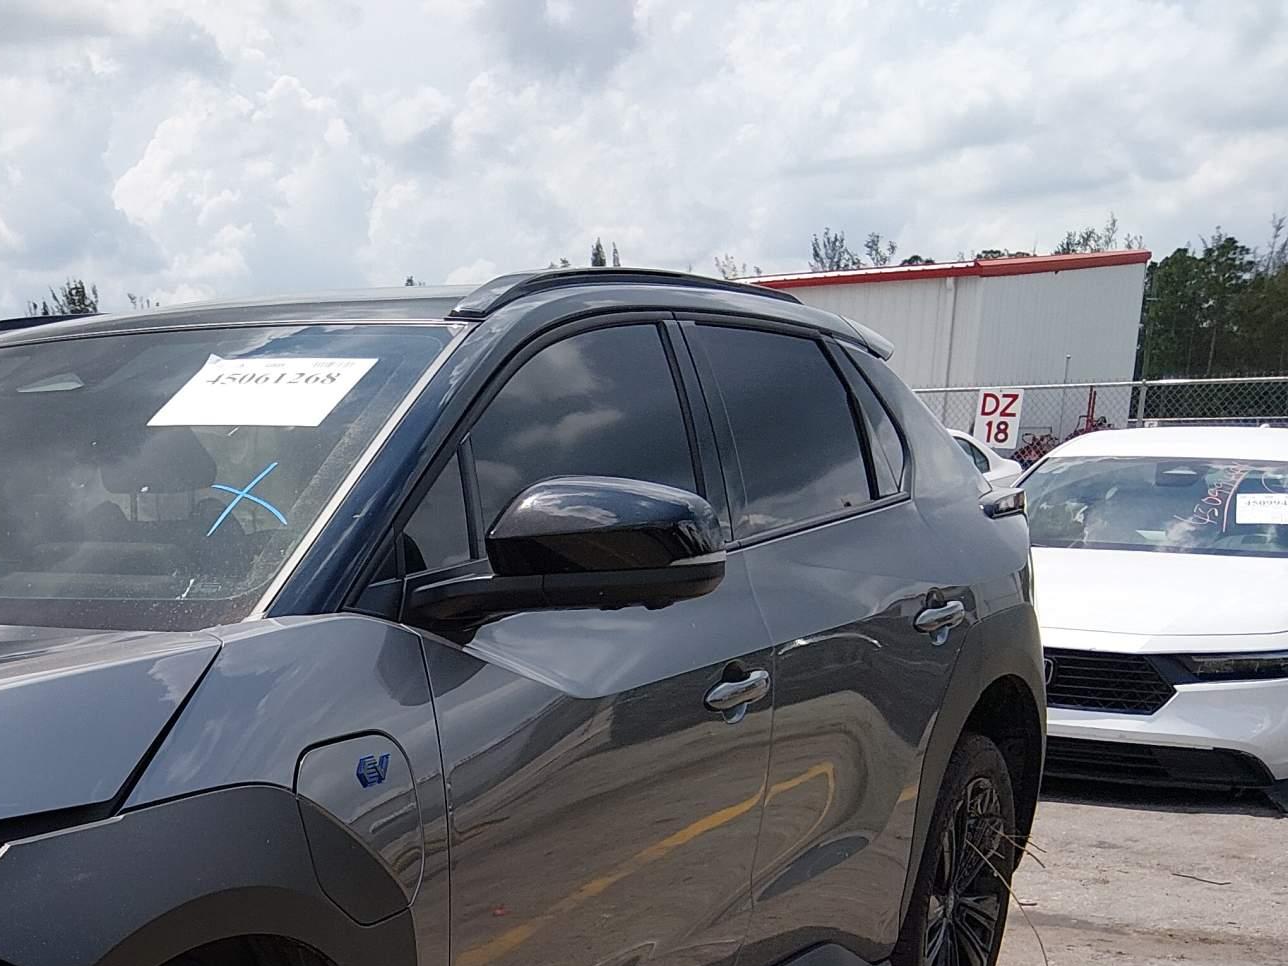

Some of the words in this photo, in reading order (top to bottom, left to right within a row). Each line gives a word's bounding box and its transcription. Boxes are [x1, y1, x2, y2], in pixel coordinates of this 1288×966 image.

[206, 372, 341, 385] 45061268
[981, 393, 1019, 417] DZ
[985, 420, 1009, 443] 18
[356, 753, 392, 789] EV
